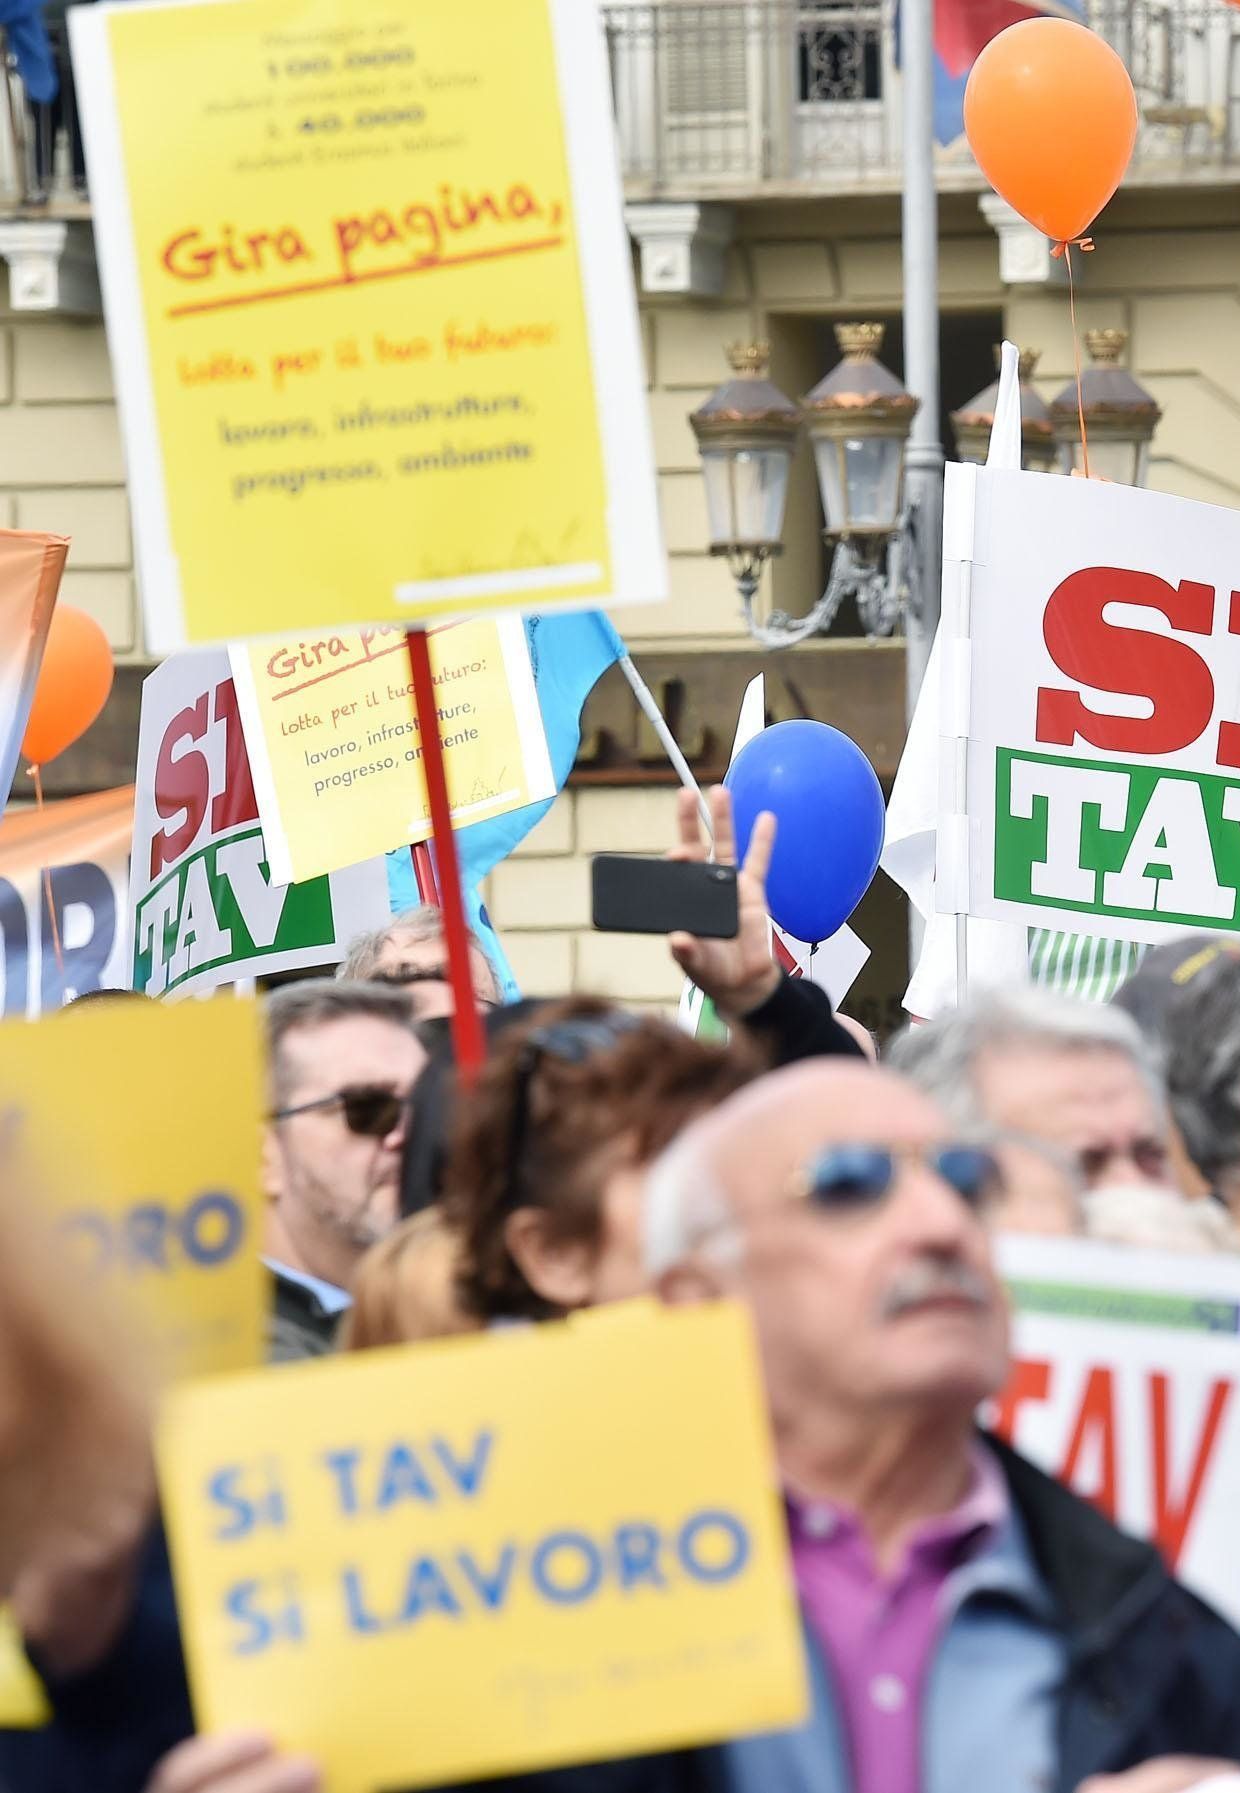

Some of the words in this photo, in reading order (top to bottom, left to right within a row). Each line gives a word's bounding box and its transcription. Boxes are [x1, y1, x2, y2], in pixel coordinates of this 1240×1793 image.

[162, 223, 310, 281] Gira
[334, 183, 563, 284] pagina,
[267, 633, 350, 679] Gira
[331, 701, 358, 729] per
[365, 690, 379, 708] il
[431, 658, 487, 686] uturo:
[304, 740, 362, 767] lavoro,
[314, 757, 399, 797] progresso,
[324, 1430, 497, 1516] TAV
[343, 1509, 752, 1636] LAVORO
